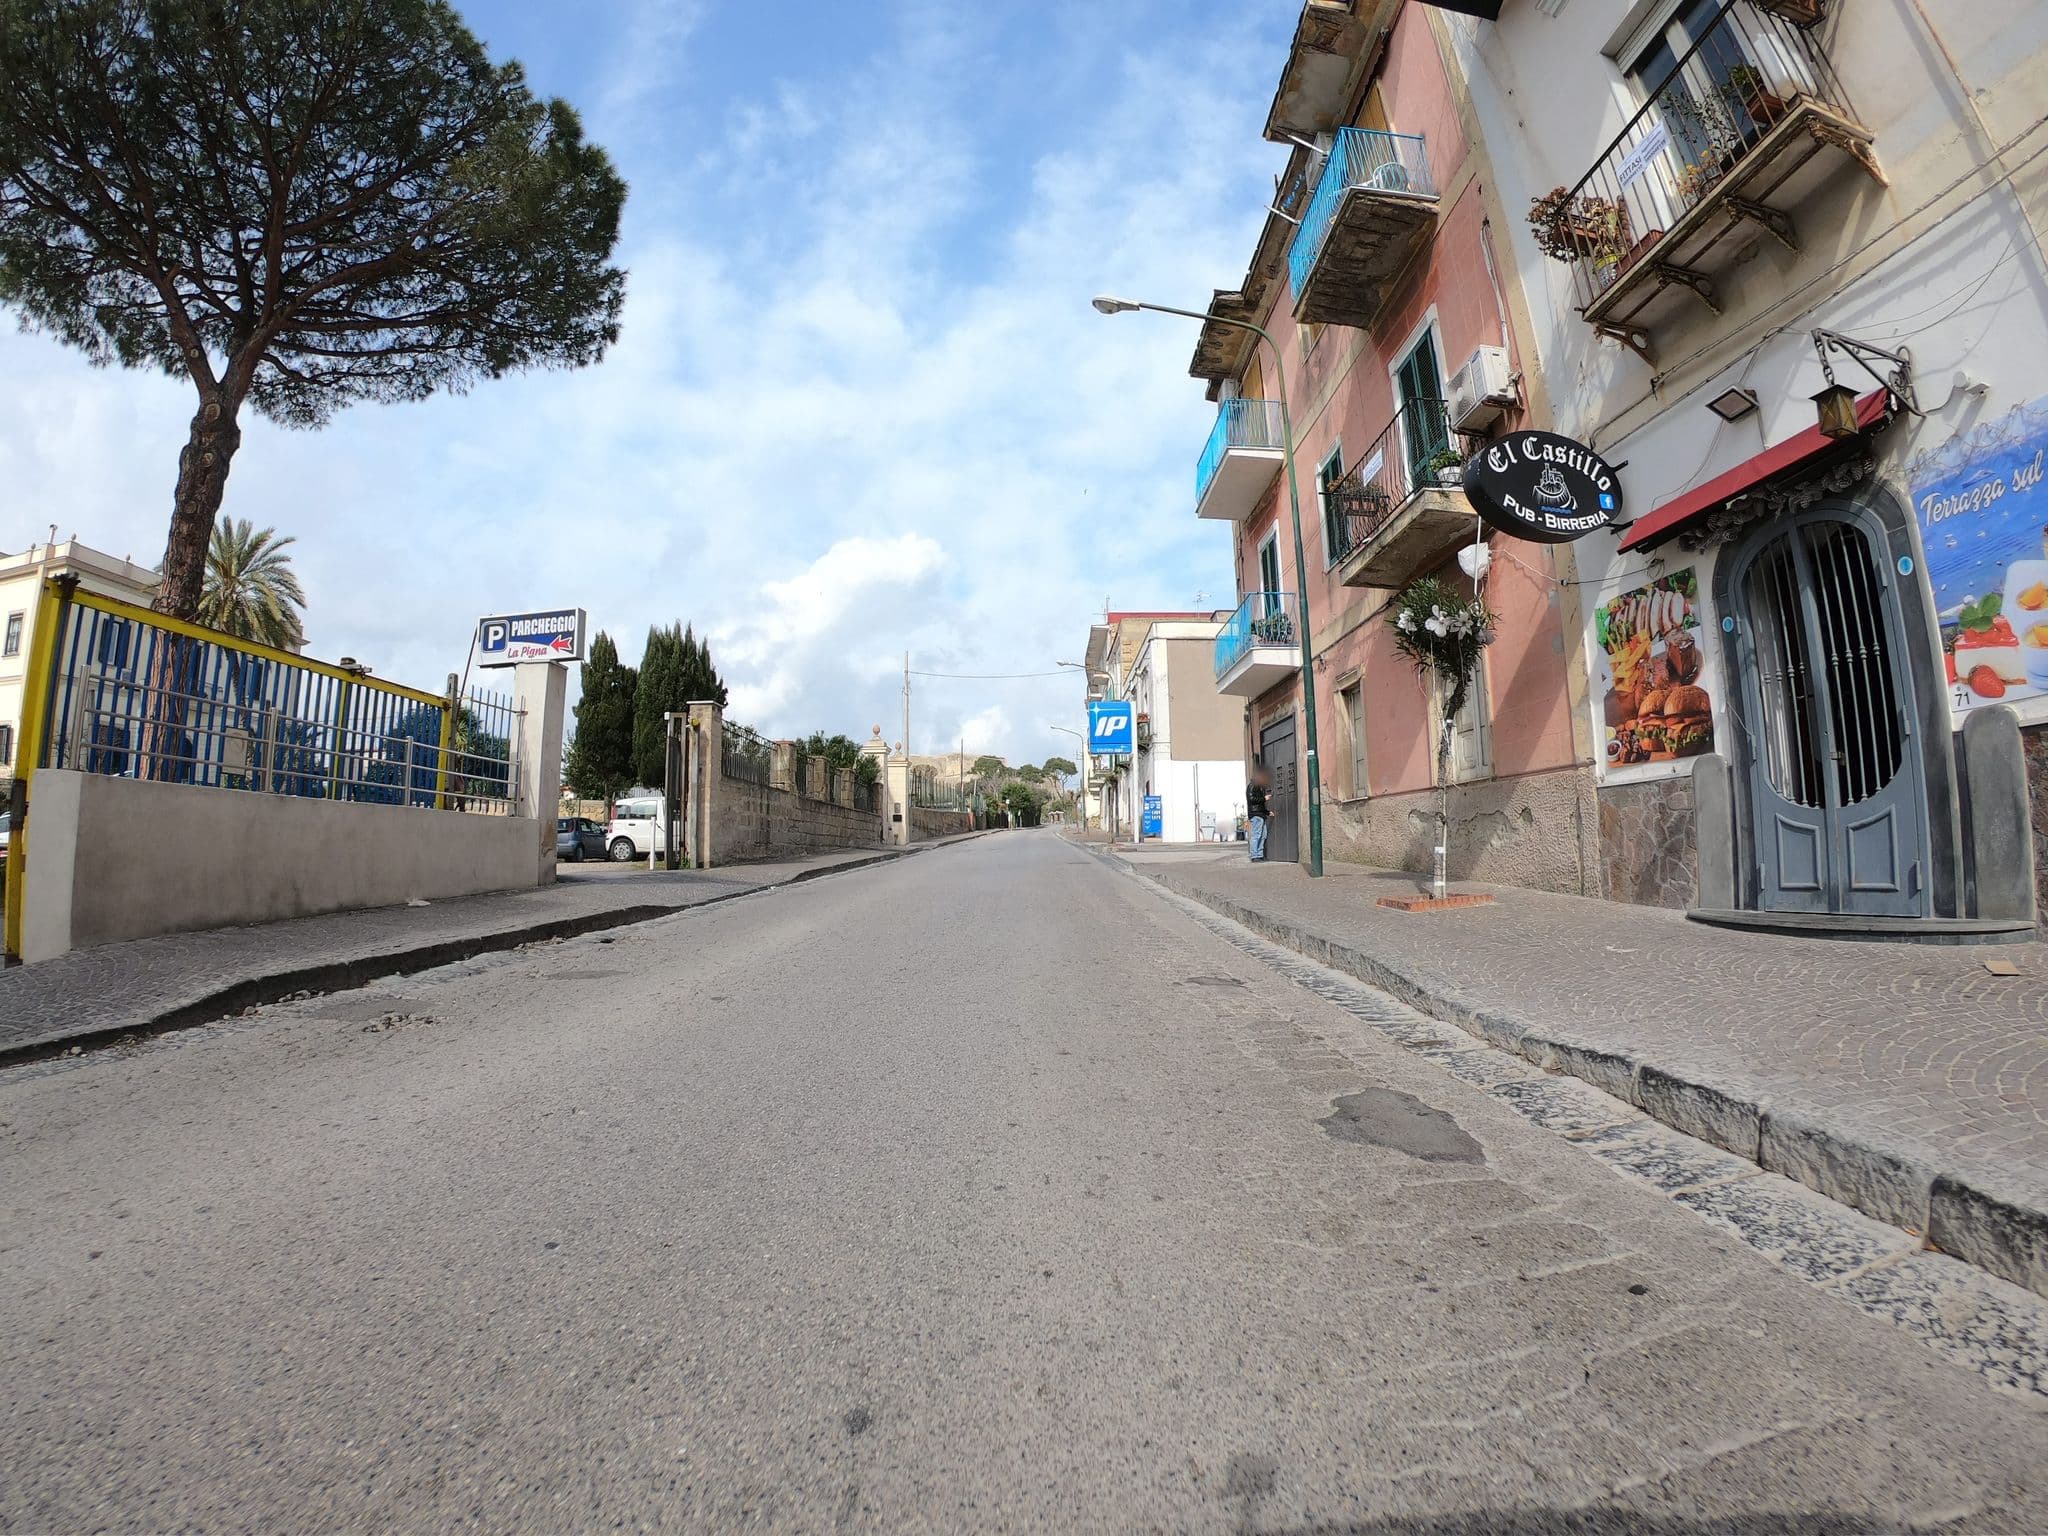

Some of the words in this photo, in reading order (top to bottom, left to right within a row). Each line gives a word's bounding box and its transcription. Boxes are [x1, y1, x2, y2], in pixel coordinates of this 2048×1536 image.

[1619, 156, 1642, 182] FITTASI
[1487, 441, 1518, 473] El
[1522, 436, 1612, 491] Castillo
[1920, 477, 2006, 527] Terrazza
[2011, 448, 2044, 492] sul
[1503, 494, 1536, 522] PUB
[1544, 510, 1610, 531] BIRRERIA
[488, 625, 504, 649] P
[511, 615, 576, 637] PARCHEGGIO
[508, 647, 519, 658] La
[520, 646, 548, 659] Pigna
[1955, 692, 1970, 707] 71
[1095, 716, 1128, 737] IP
